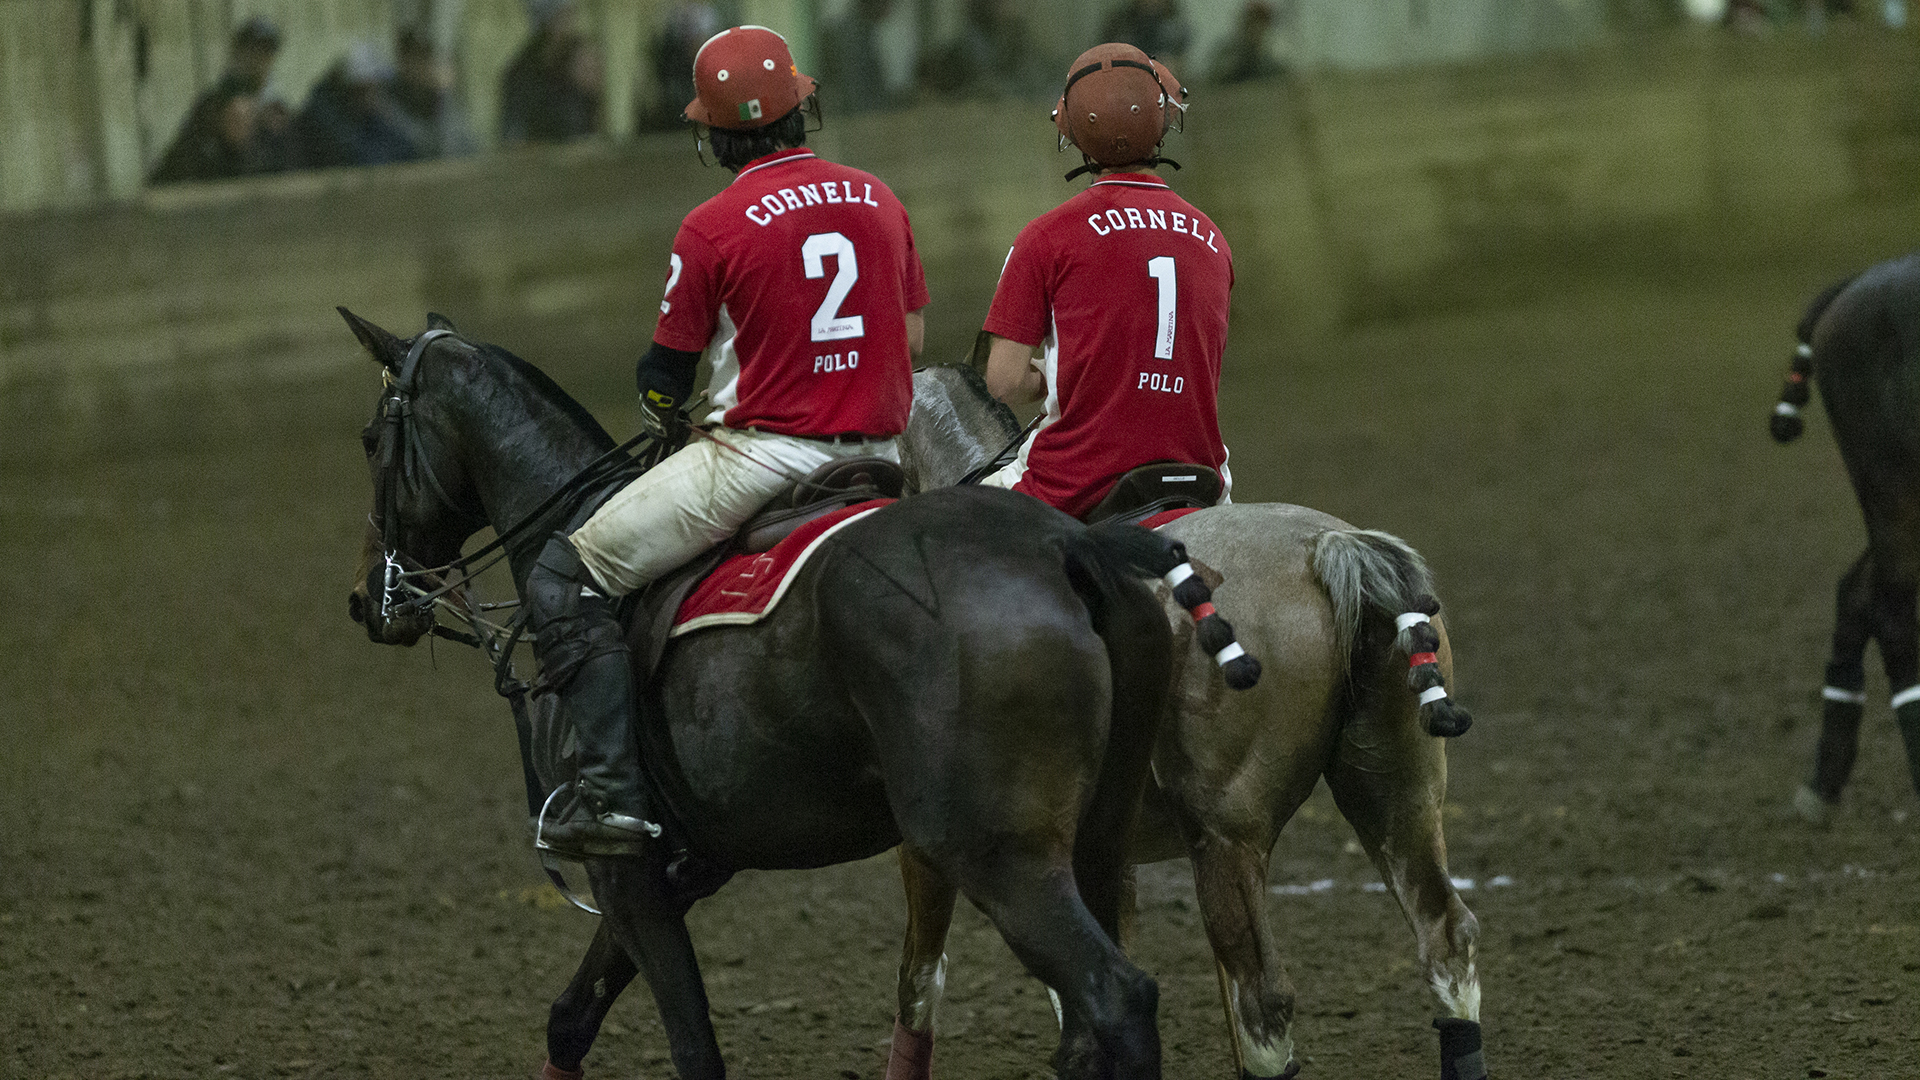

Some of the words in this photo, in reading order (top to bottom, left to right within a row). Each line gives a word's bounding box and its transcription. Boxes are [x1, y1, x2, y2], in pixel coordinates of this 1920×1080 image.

[745, 181, 878, 226] CORNELL
[1088, 208, 1218, 253] CORNELL
[801, 231, 865, 342] 2
[1148, 255, 1177, 360] 1
[813, 350, 859, 373] POLO
[1138, 372, 1184, 394] POLO
